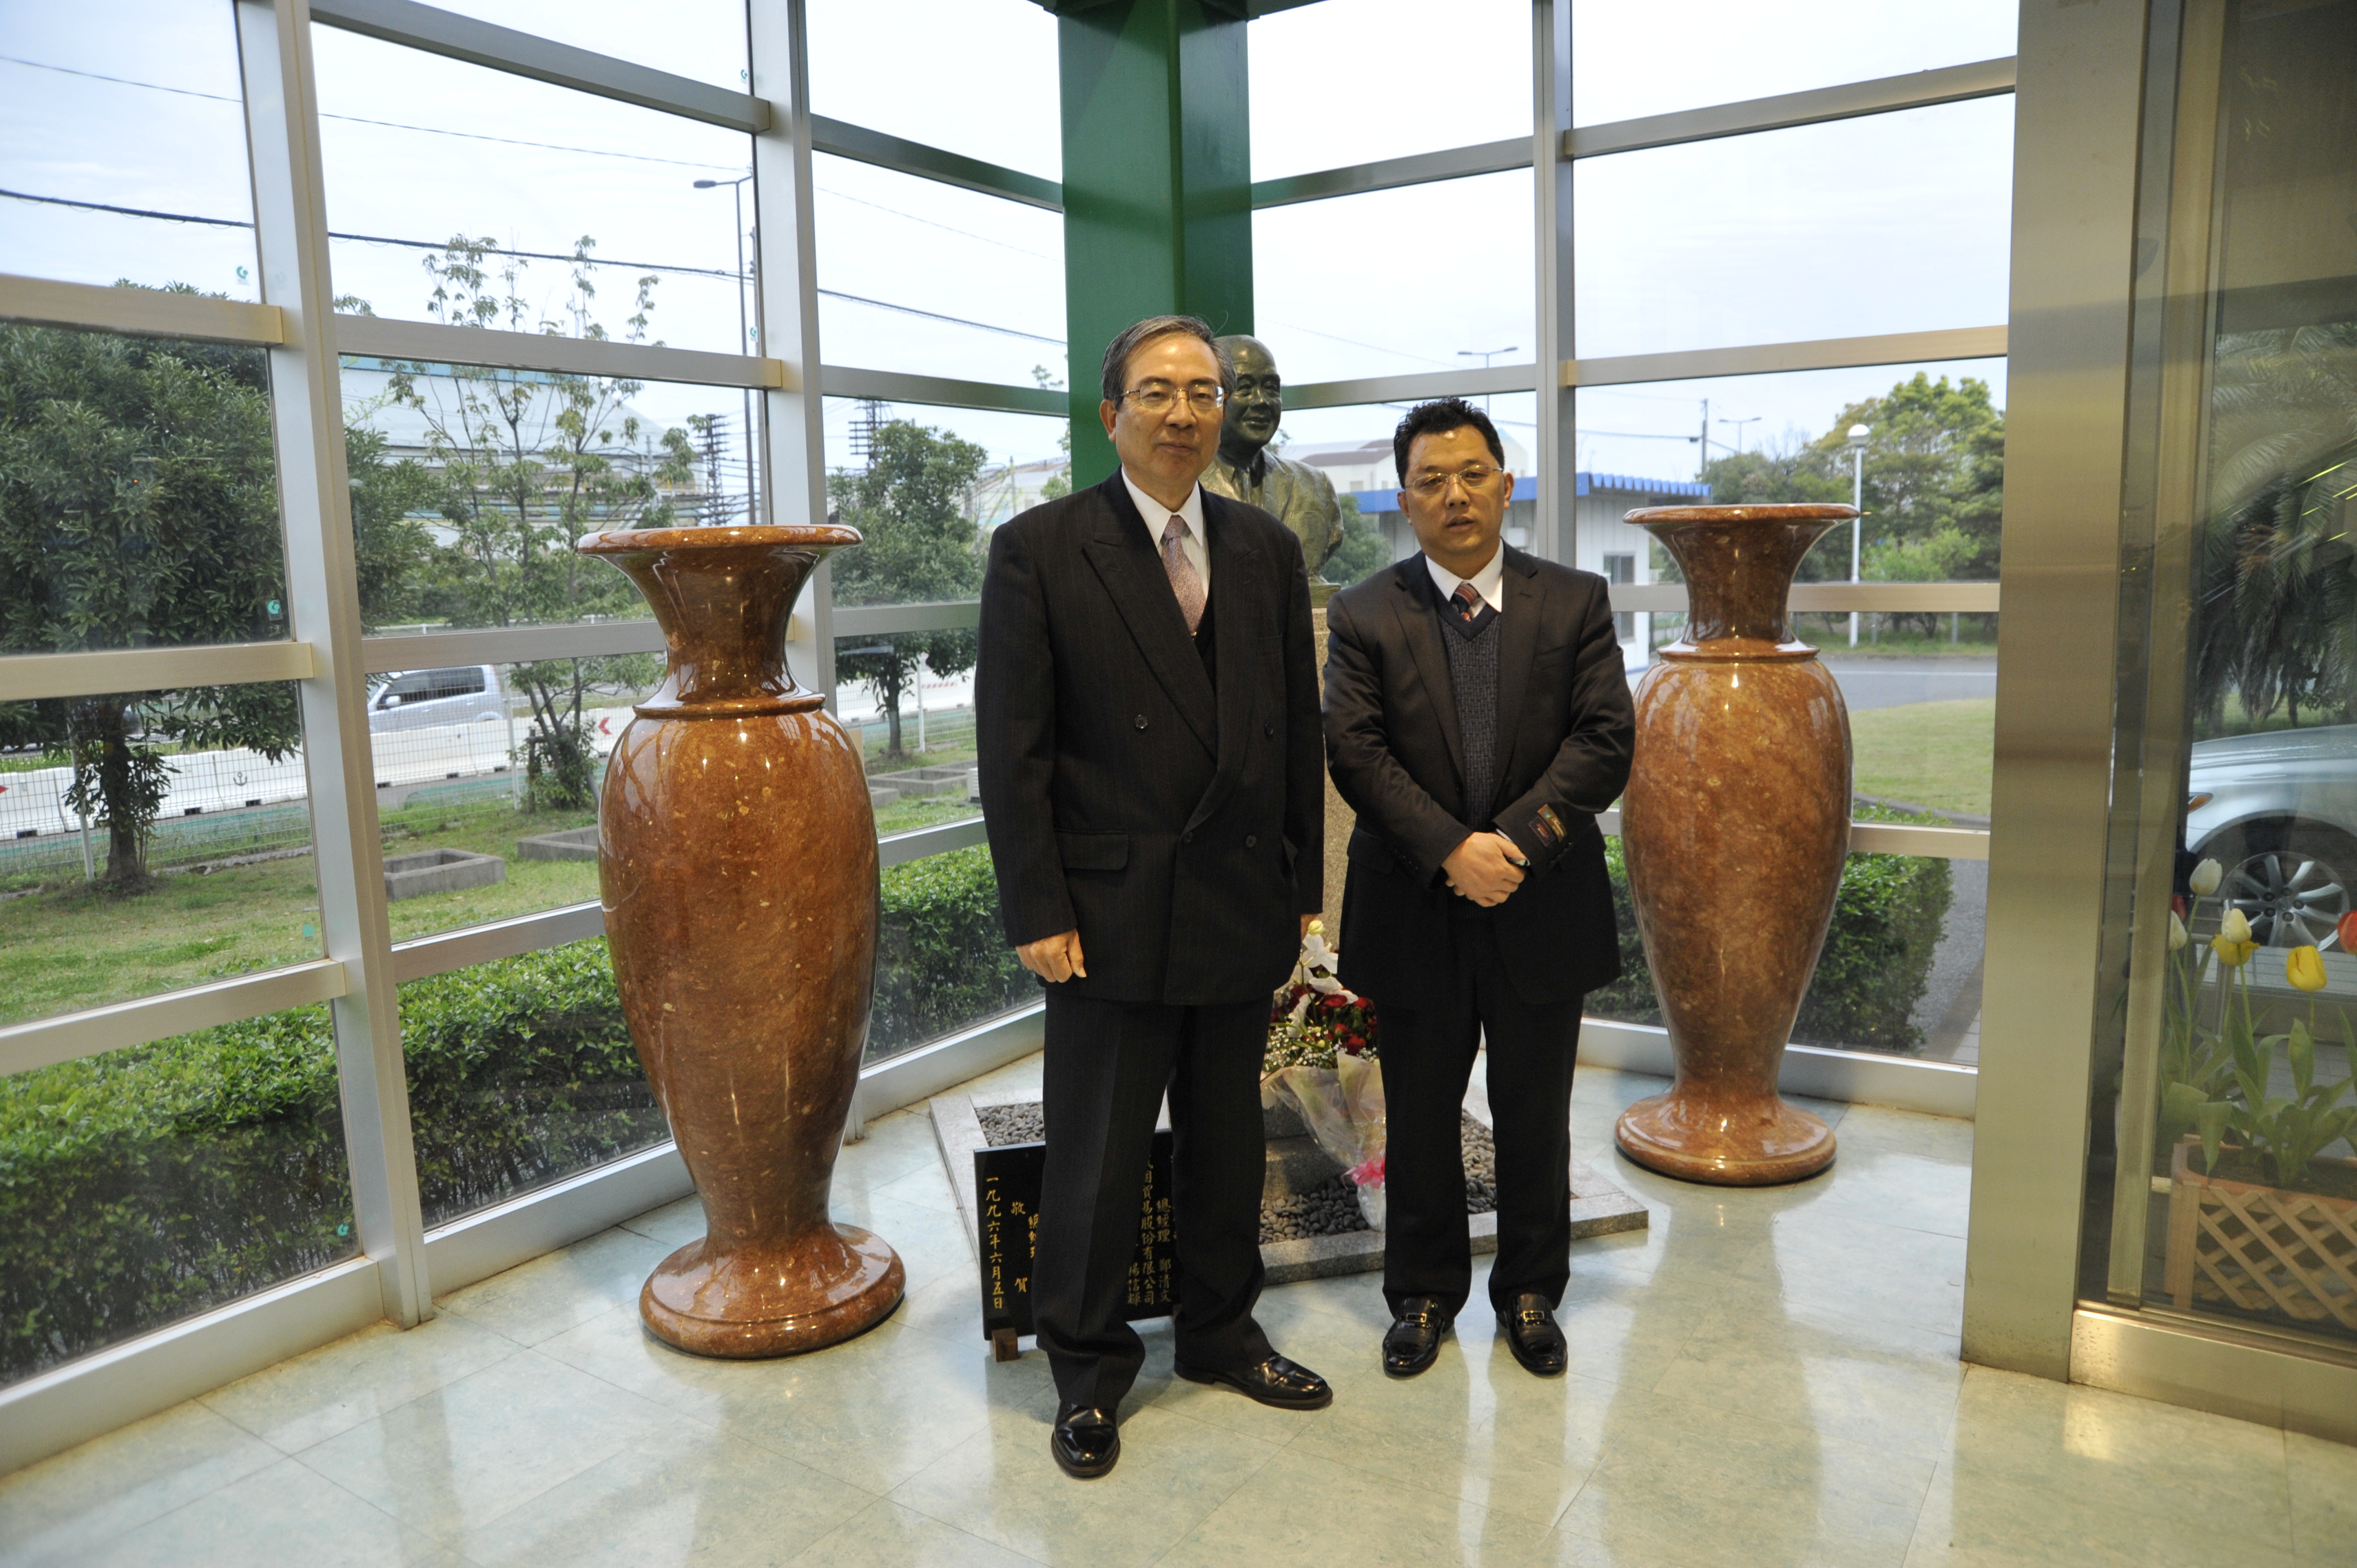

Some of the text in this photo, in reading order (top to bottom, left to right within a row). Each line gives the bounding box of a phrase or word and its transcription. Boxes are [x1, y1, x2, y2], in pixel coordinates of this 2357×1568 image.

[985, 1177, 1004, 1309] 一九九六年六月五日
[1011, 1201, 1028, 1293] 敬 賀
